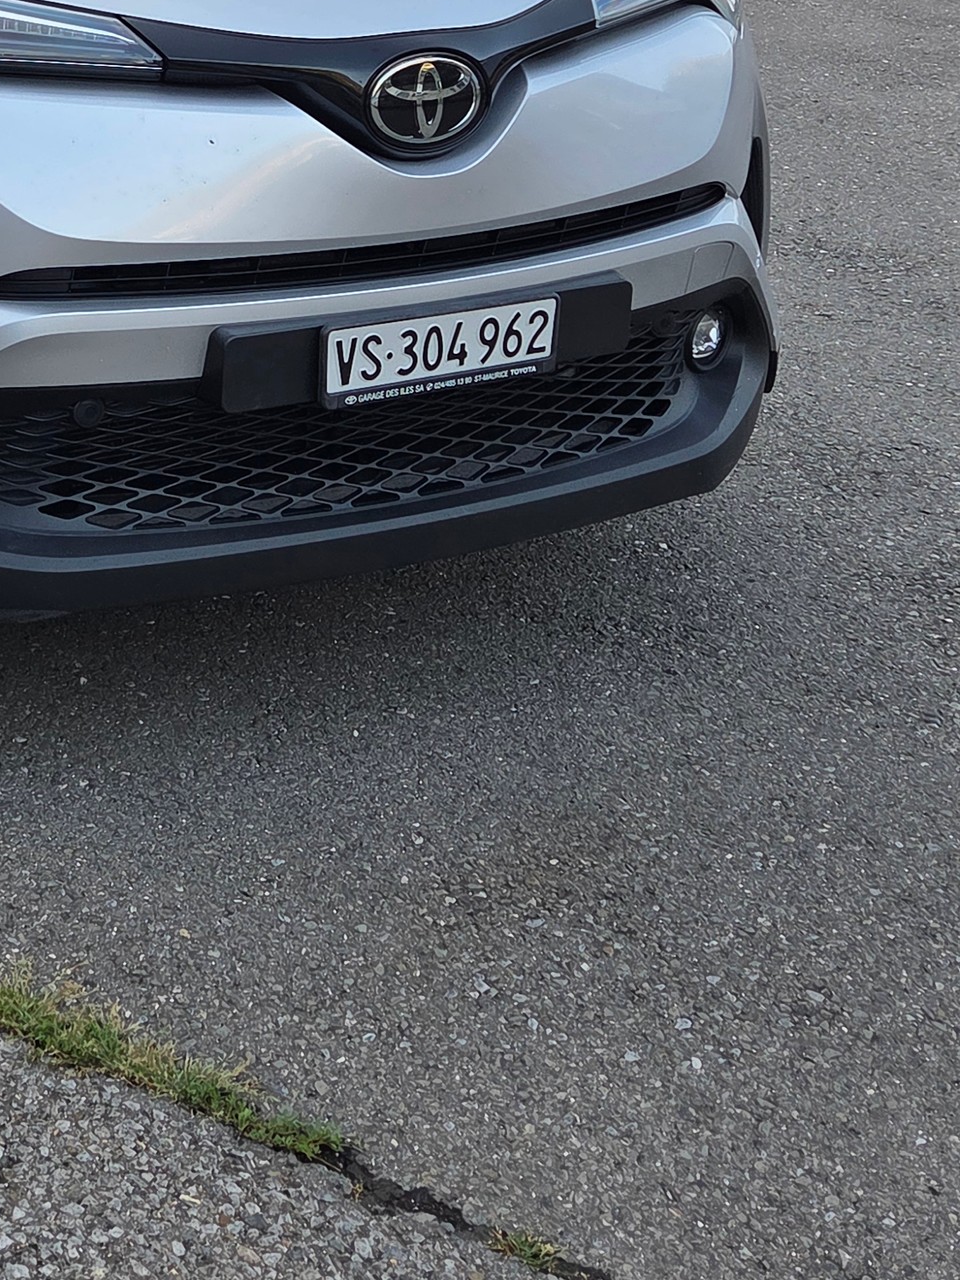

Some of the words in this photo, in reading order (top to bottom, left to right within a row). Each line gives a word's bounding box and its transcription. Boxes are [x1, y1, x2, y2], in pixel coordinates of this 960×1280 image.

[358, 390, 385, 402] GARAGE
[385, 388, 399, 398] DES
[415, 384, 425, 393] SA
[510, 365, 537, 376] TOYOTA
